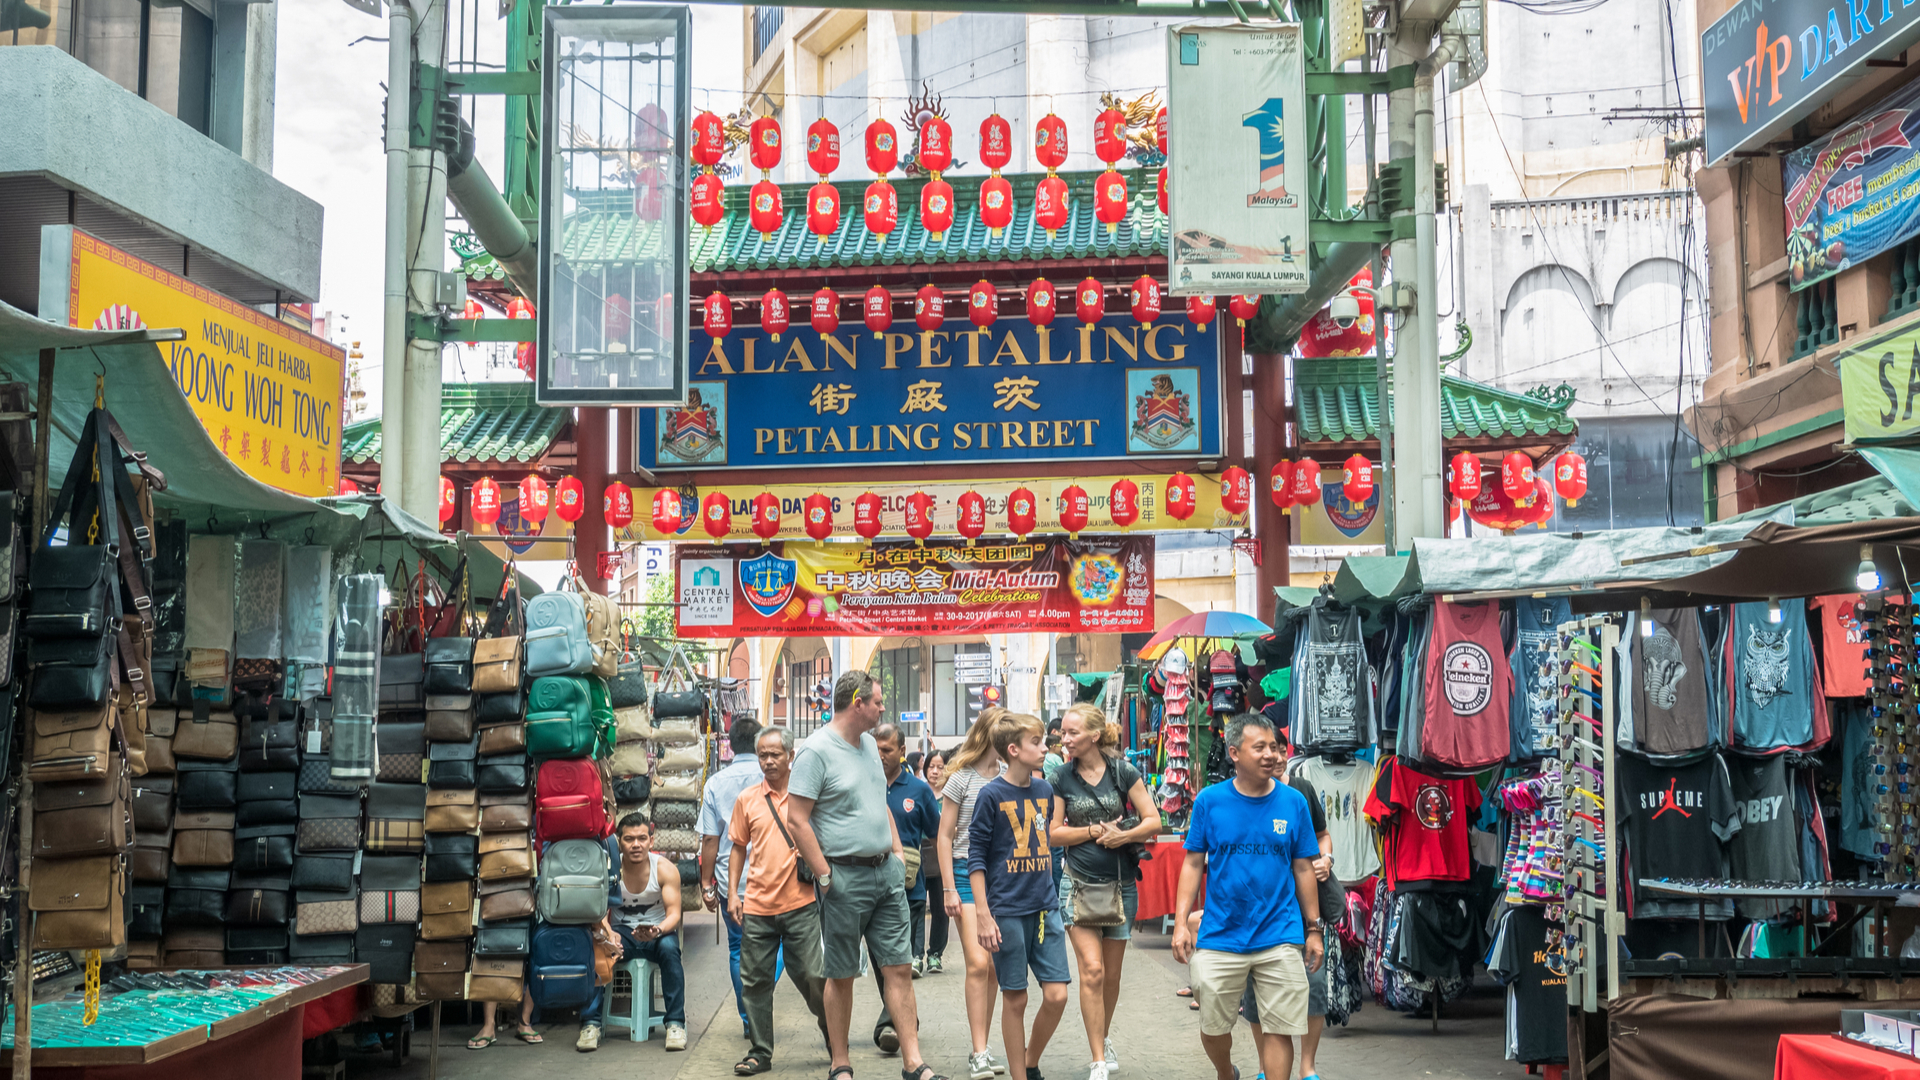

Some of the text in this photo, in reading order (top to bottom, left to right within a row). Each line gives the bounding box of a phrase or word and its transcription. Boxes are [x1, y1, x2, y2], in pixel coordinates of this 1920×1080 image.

[1794, 128, 1863, 221] Grand Opening
[1251, 194, 1293, 206] Malaysia
[1826, 174, 1863, 216] FREE
[1823, 219, 1844, 240] beer
[1853, 200, 1883, 227] bucket
[1892, 188, 1900, 206] 5
[1211, 271, 1305, 280] SAYANGI KUALA LUMPUR
[202, 318, 311, 384] MENJUAL JELI HARBA
[690, 323, 1188, 376] ALAN PETALING
[171, 342, 331, 446] KOONG WOH TONG
[754, 419, 1099, 455] PETALING STREET
[1141, 482, 1155, 523] 丙申年
[815, 568, 945, 592] 中秋晚会
[952, 571, 1059, 590] Mid-Autum
[684, 588, 730, 596] CENTRAL
[684, 596, 730, 604] MARKET
[841, 592, 957, 608] Perayaan Kuih Bulan
[958, 589, 1041, 606] Celebration
[839, 616, 863, 624] Petaling
[1039, 609, 1071, 619] 4.00pm
[1541, 978, 1561, 986] KUALA
